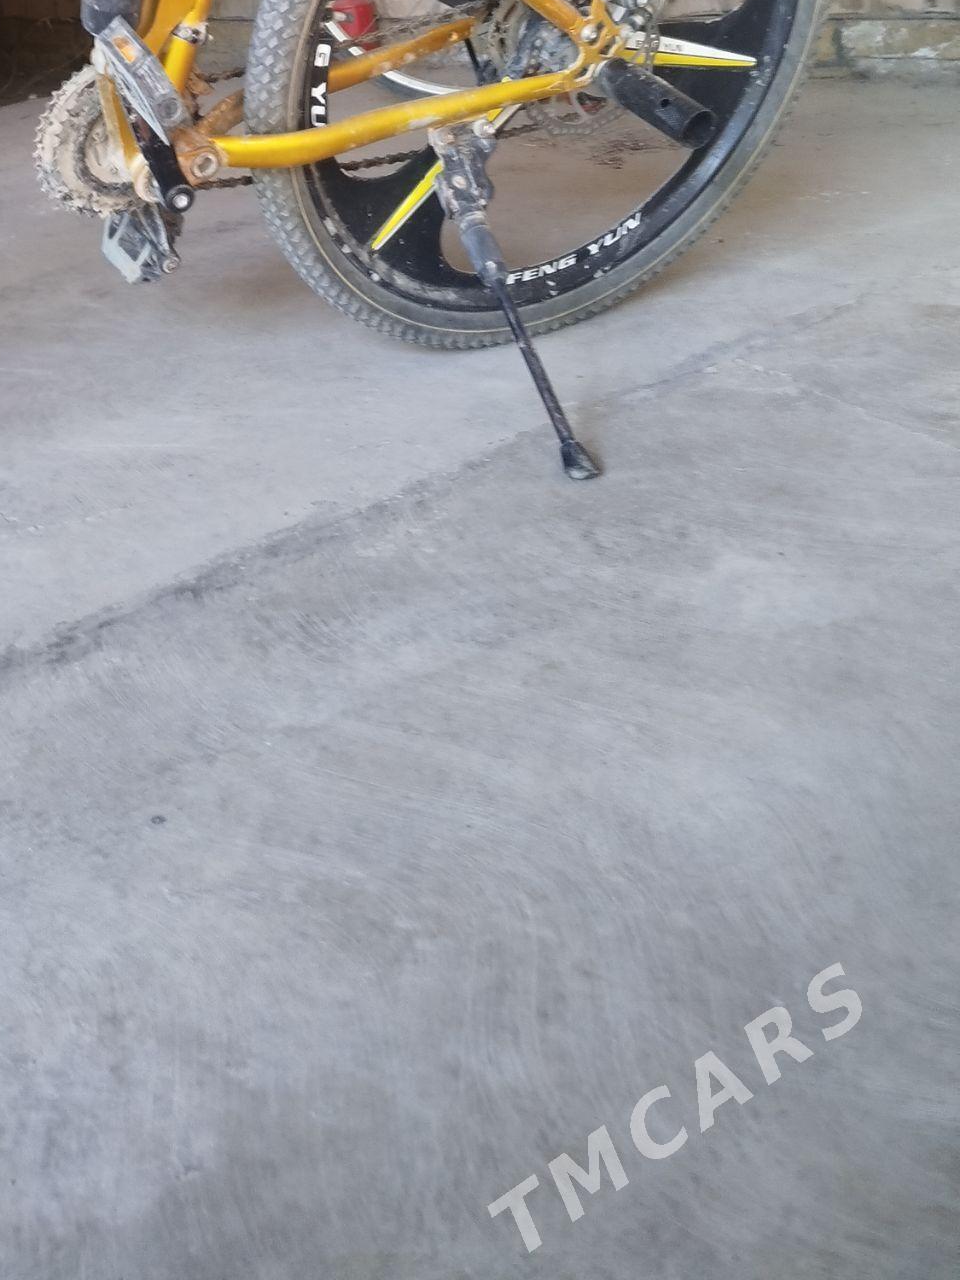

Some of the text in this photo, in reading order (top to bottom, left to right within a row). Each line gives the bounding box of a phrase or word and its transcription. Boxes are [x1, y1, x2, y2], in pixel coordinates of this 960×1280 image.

[310, 82, 327, 127] YU
[505, 212, 642, 285] FENG YUN
